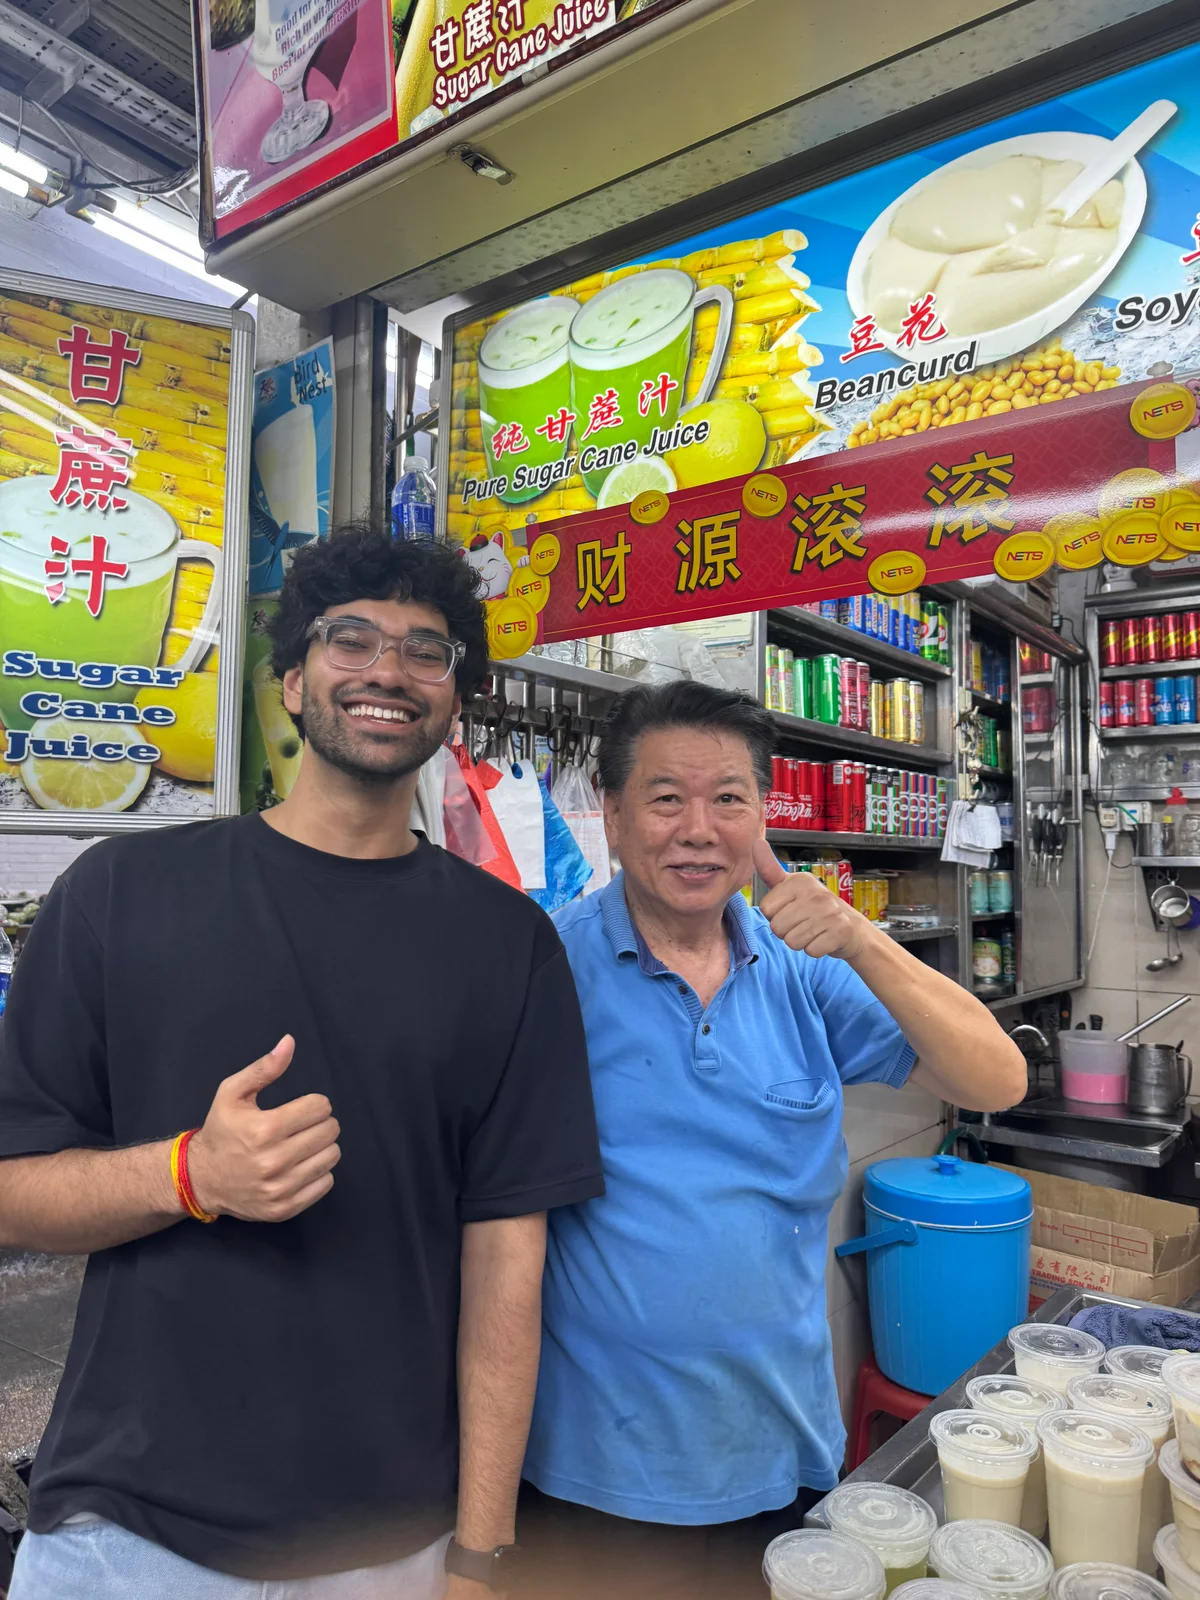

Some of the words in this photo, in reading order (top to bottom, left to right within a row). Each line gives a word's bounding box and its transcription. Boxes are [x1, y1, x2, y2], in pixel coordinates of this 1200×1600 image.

[281, 28, 301, 56] Rich
[431, 0, 524, 69] 甘蔗汁
[434, 56, 492, 106] Sugar
[495, 26, 548, 73] Cane
[550, 0, 608, 42] Juice
[272, 57, 293, 82] Best
[1115, 286, 1200, 330] Soy
[841, 295, 947, 363] 豆花
[294, 352, 320, 384] Bird
[814, 340, 977, 409] Beancurd
[299, 377, 328, 405] Nest
[492, 374, 678, 459] 纯甘蔗汁
[1143, 400, 1184, 421] NETS
[44, 324, 142, 618] 甘蔗汁
[462, 475, 508, 504] Pure
[512, 456, 577, 489] Sugar
[580, 440, 637, 473] Cane
[643, 420, 710, 455] Juice
[638, 499, 662, 515] NETS
[751, 487, 779, 503] NETS
[576, 451, 1016, 612] 财源滚滚
[1116, 533, 1158, 545] NETS
[1174, 520, 1200, 532] NET
[535, 548, 555, 560] NETS
[1006, 551, 1043, 561] NETS
[1064, 531, 1101, 554] NETS
[880, 566, 914, 579] NETS
[516, 580, 542, 597] NETS
[497, 620, 528, 635] NETS
[3, 650, 186, 689] Sugar
[20, 692, 177, 727] Cane
[4, 729, 162, 766] Juice
[1031, 1268, 1067, 1284] TRADING
